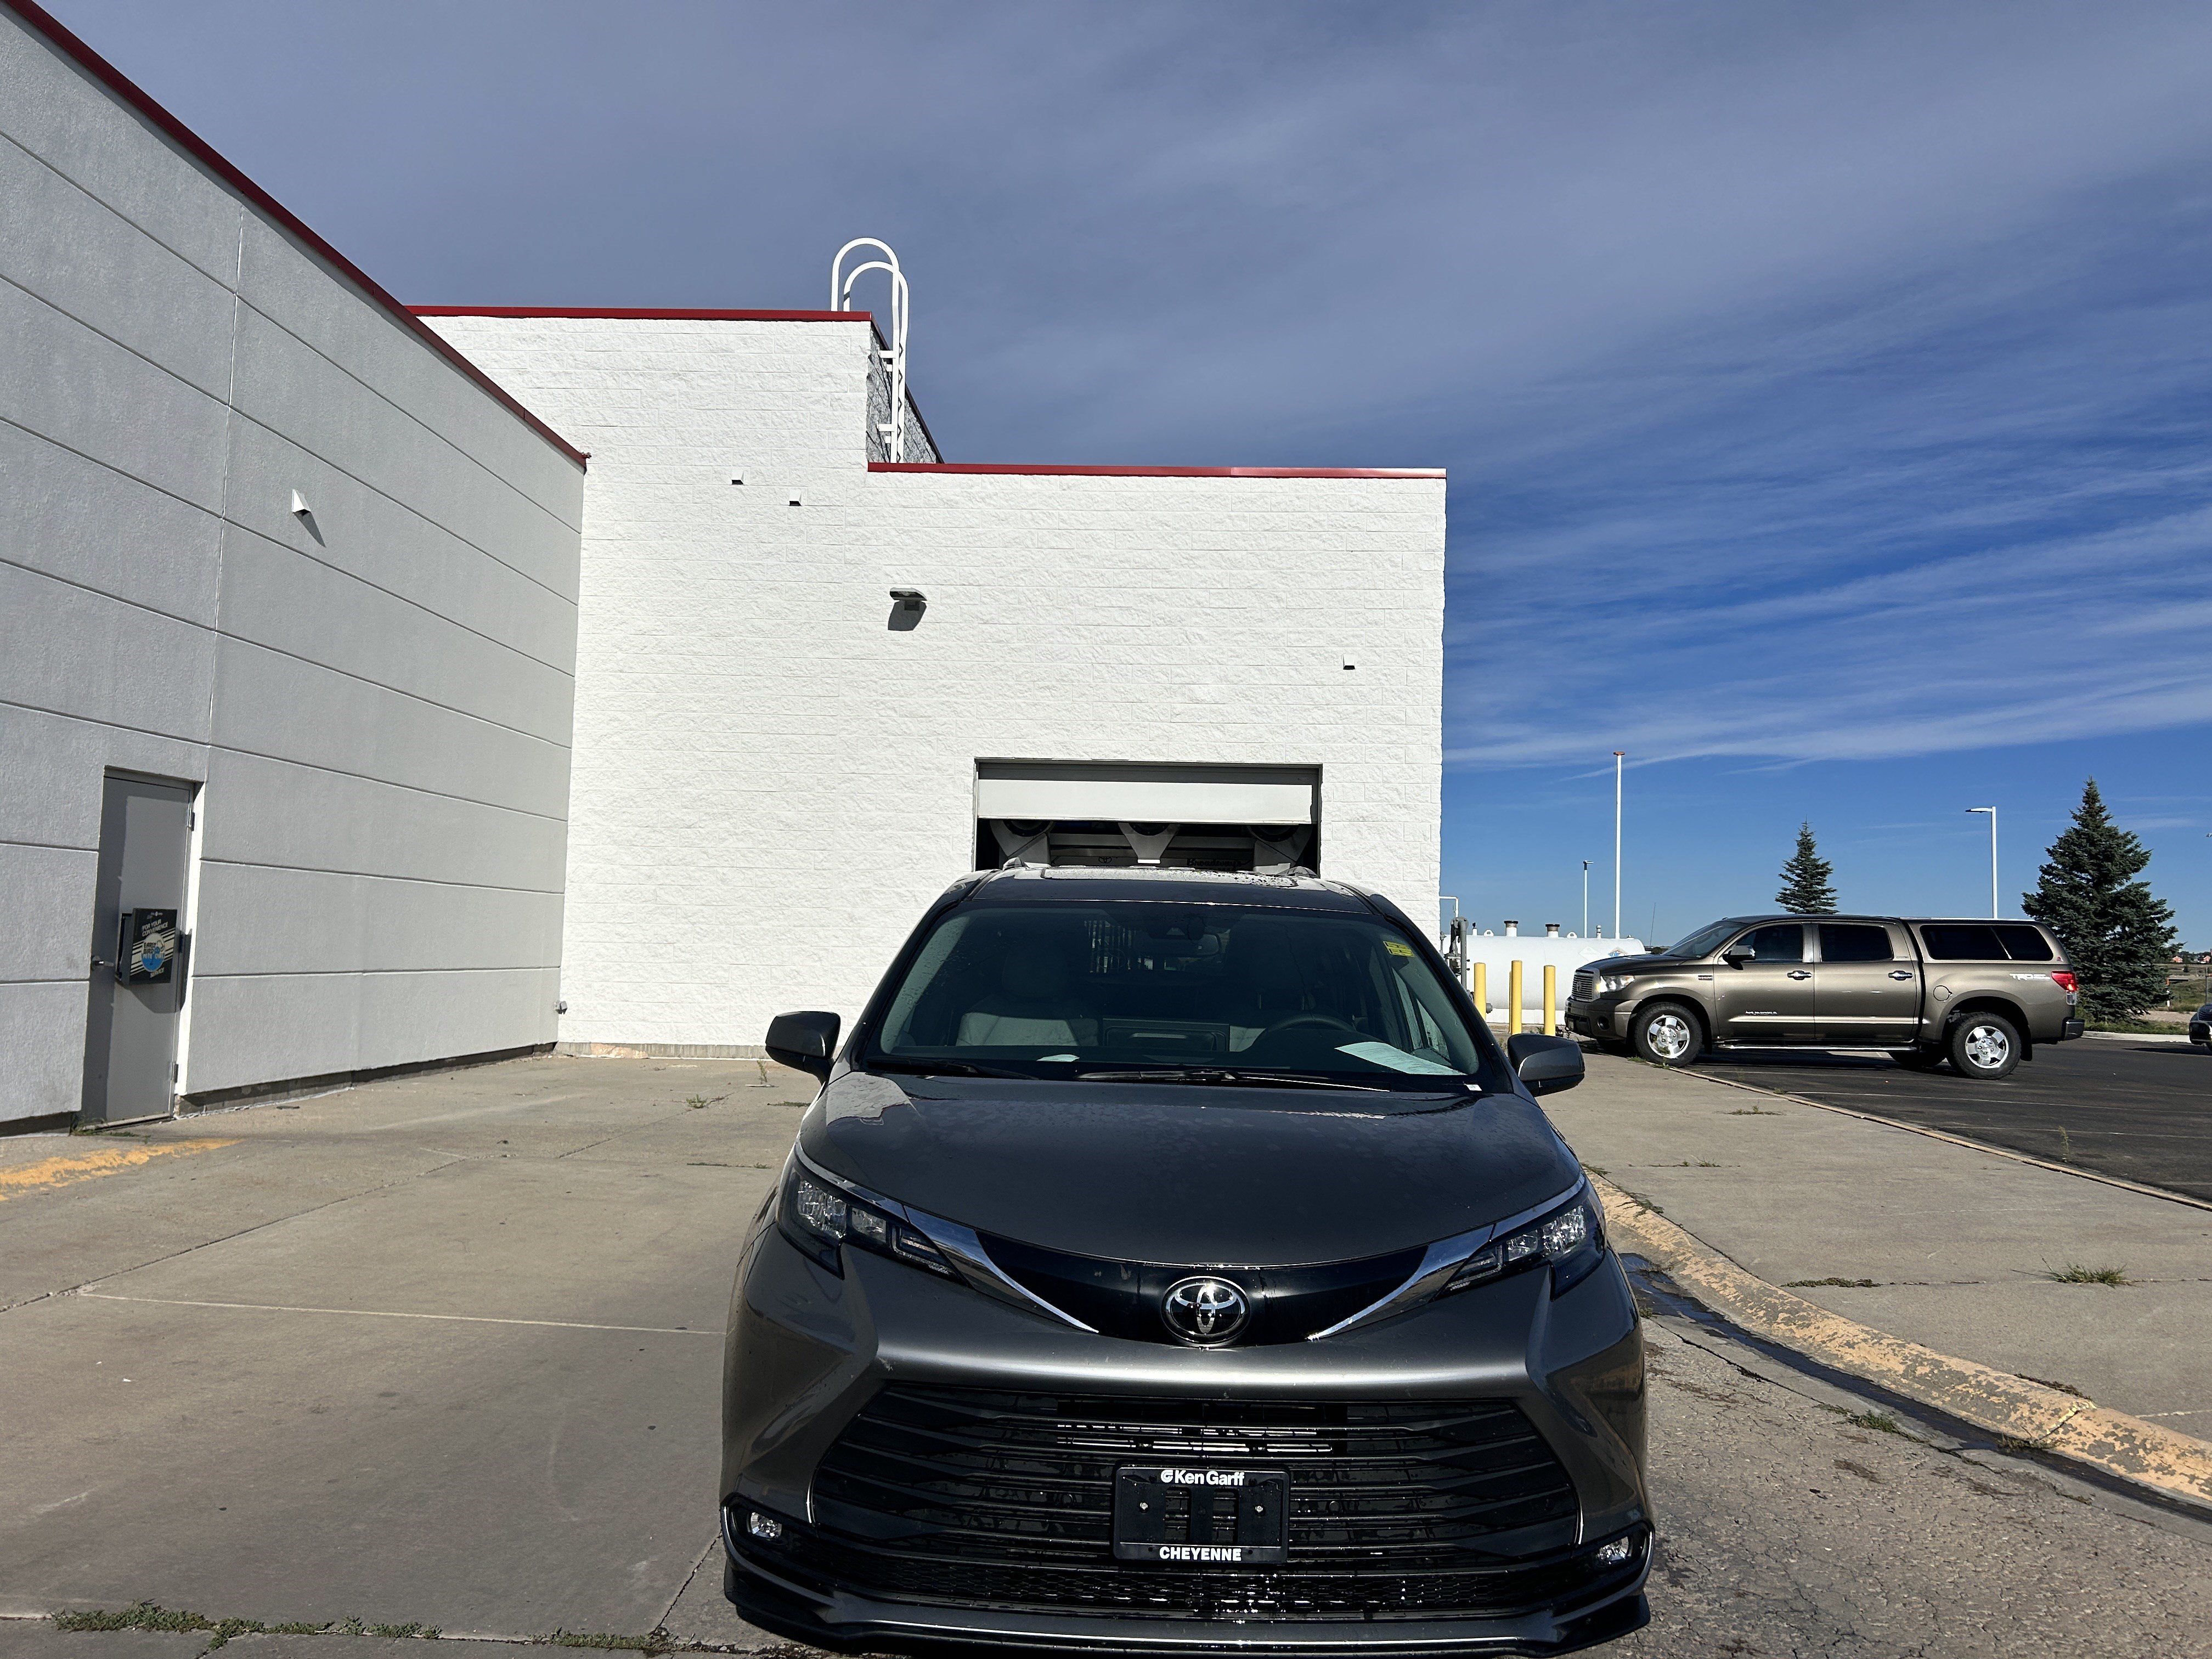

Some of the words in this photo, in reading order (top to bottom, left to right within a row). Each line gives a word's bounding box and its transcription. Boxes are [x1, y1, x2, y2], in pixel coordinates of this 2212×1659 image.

[142, 923, 150, 932] FOR
[151, 918, 162, 927] YOUR
[142, 922, 168, 937] CONVENIENCE
[1175, 1470, 1204, 1484] Ken
[1206, 1471, 1244, 1486] Garff
[1159, 1547, 1242, 1561] CHEYENNE
